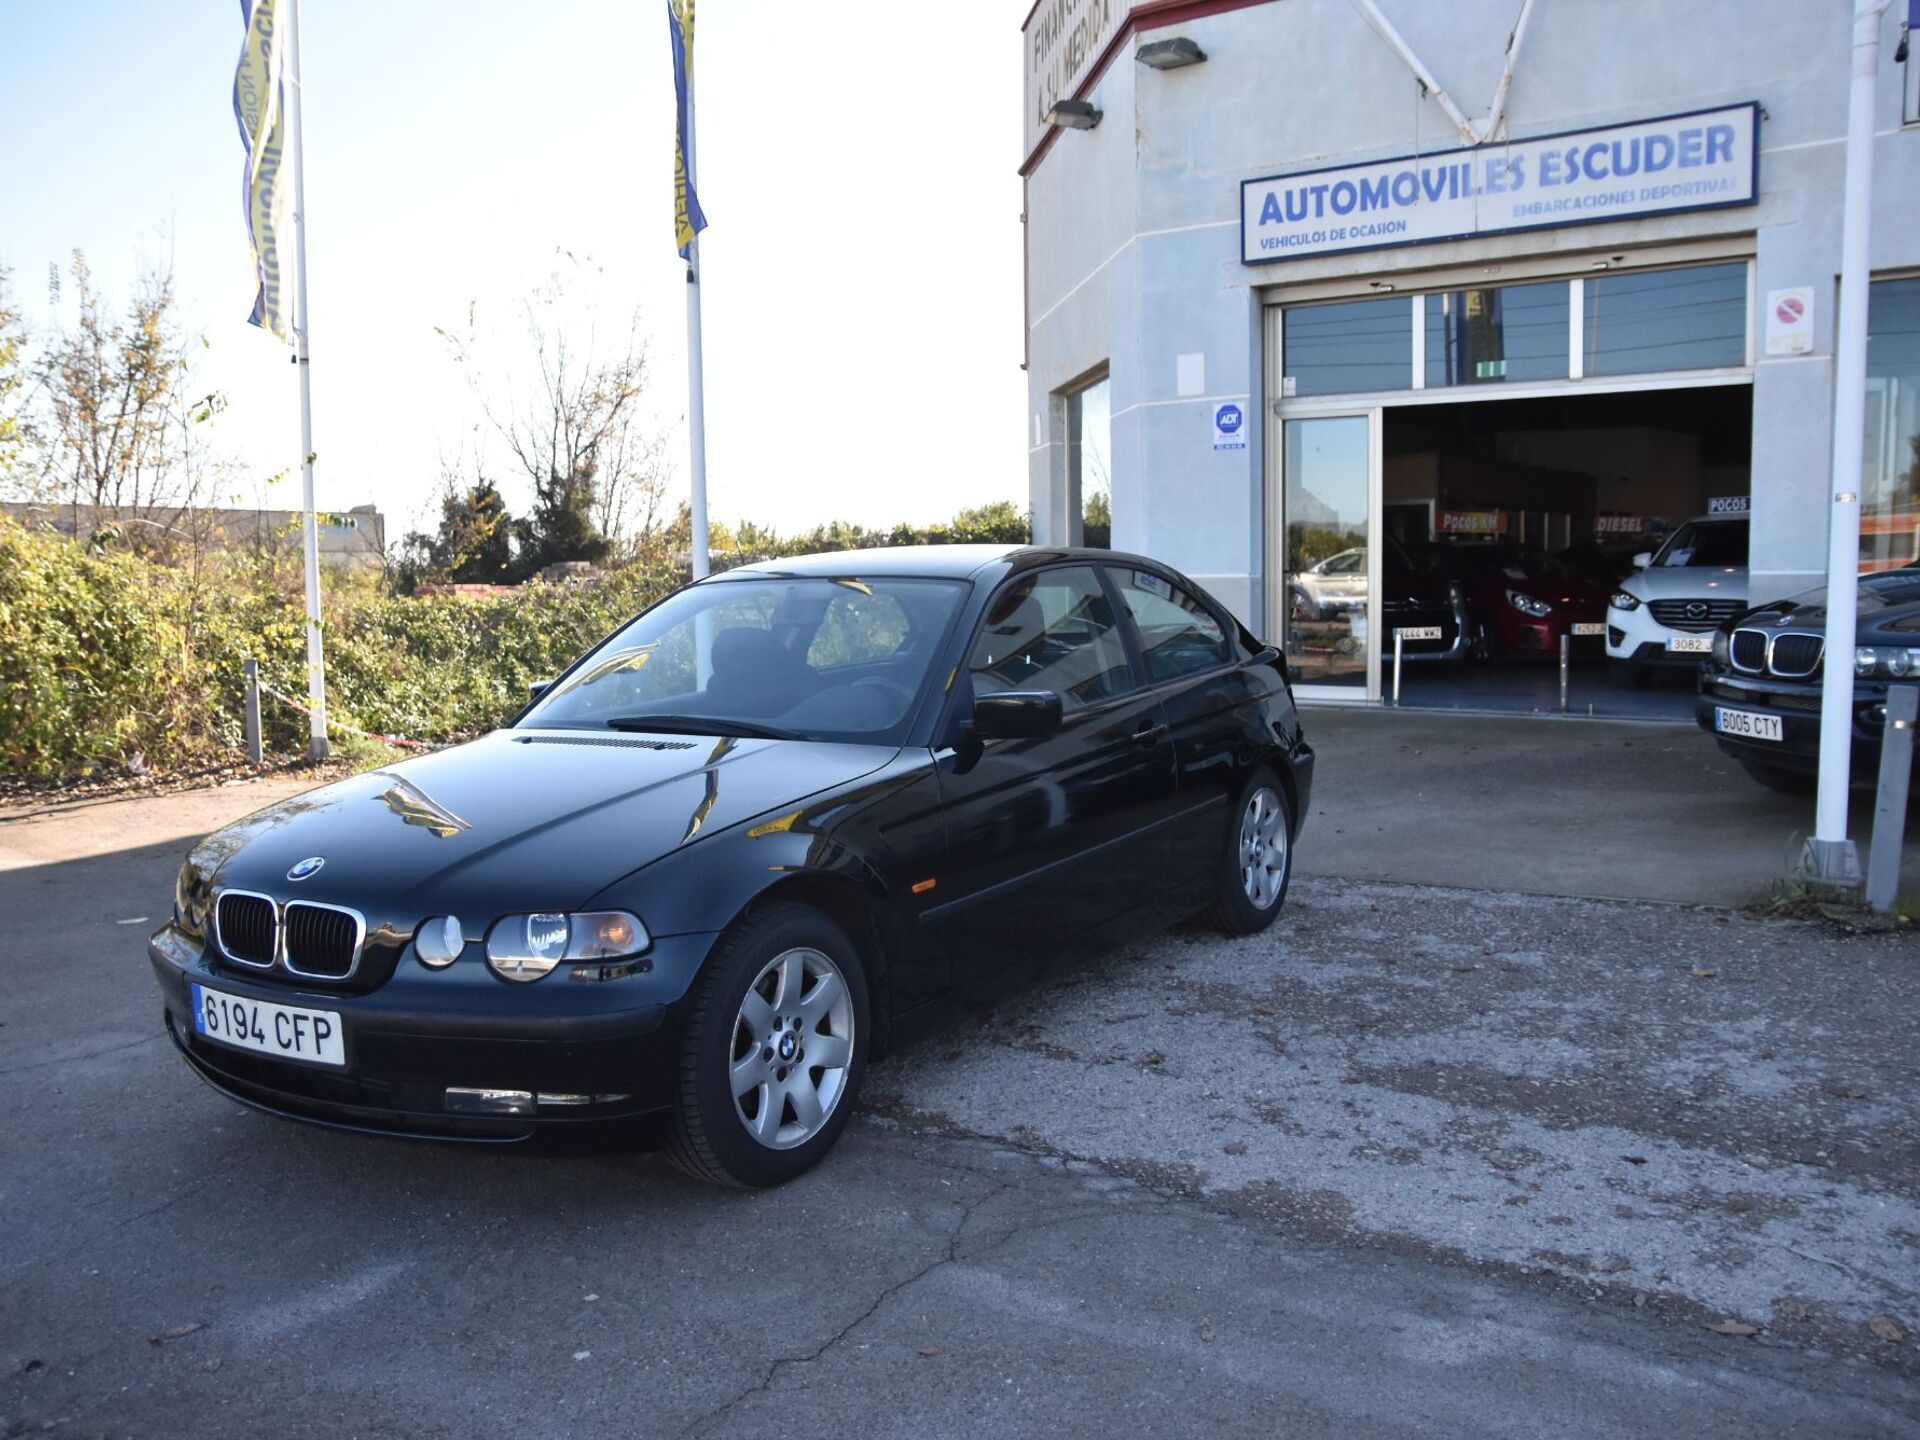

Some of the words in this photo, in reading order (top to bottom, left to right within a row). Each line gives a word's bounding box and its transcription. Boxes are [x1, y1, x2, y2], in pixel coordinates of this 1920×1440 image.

[1259, 154, 1525, 226] AUTOMOVILES
[1538, 124, 1736, 187] ESCUDER
[1512, 190, 1636, 218] EMBARCACIONES
[1260, 230, 1327, 250] VEHICULOS
[1329, 227, 1347, 241] DE
[1349, 219, 1407, 239] OCASION
[1220, 413, 1239, 425] ADT
[1711, 499, 1748, 512] POCOS
[1597, 516, 1643, 533] DIESEL
[1674, 638, 1702, 650] 3082
[1722, 711, 1751, 733] 6005
[1753, 715, 1780, 737] CTY
[205, 994, 266, 1045] 6194
[274, 1011, 332, 1055] CFP
